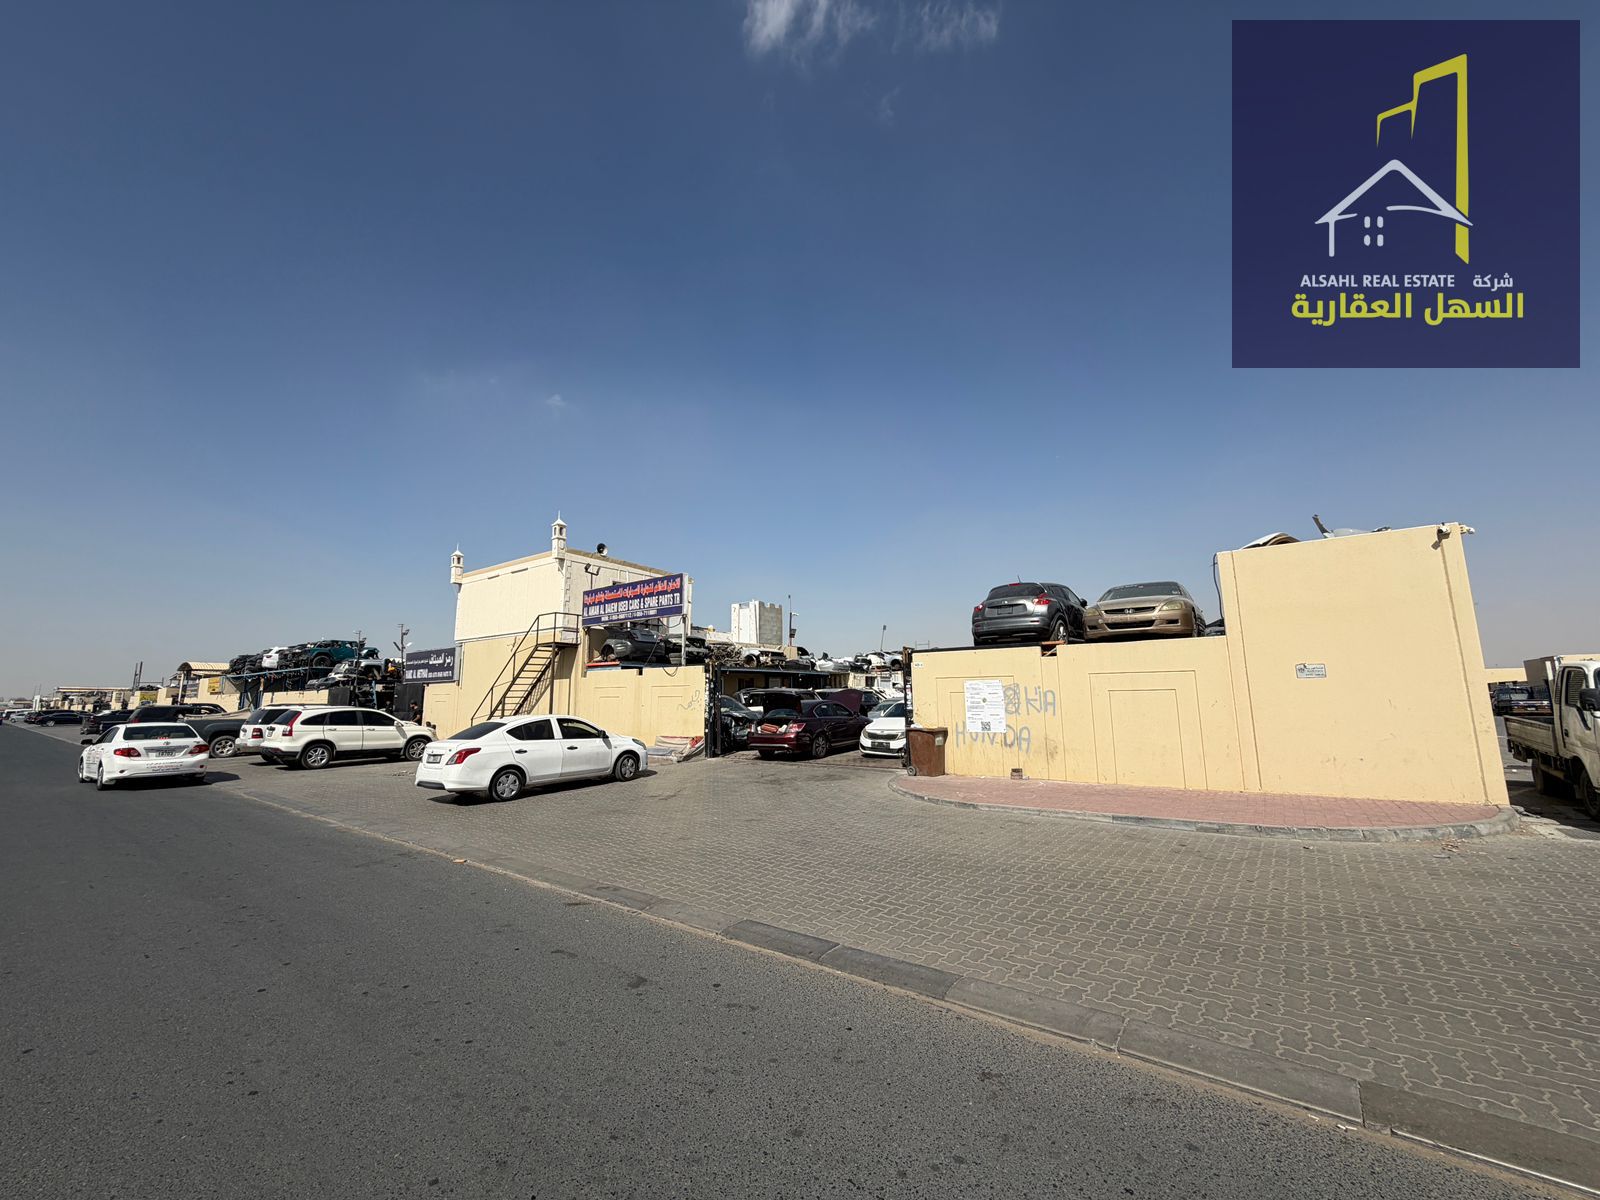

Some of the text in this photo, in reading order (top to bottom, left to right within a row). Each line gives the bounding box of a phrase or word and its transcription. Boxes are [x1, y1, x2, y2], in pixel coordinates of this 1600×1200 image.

[618, 600, 628, 612] USED
[629, 598, 639, 610] CARS
[644, 596, 658, 609] SPARE
[658, 594, 673, 606] PARTS
[674, 593, 680, 604] TR
